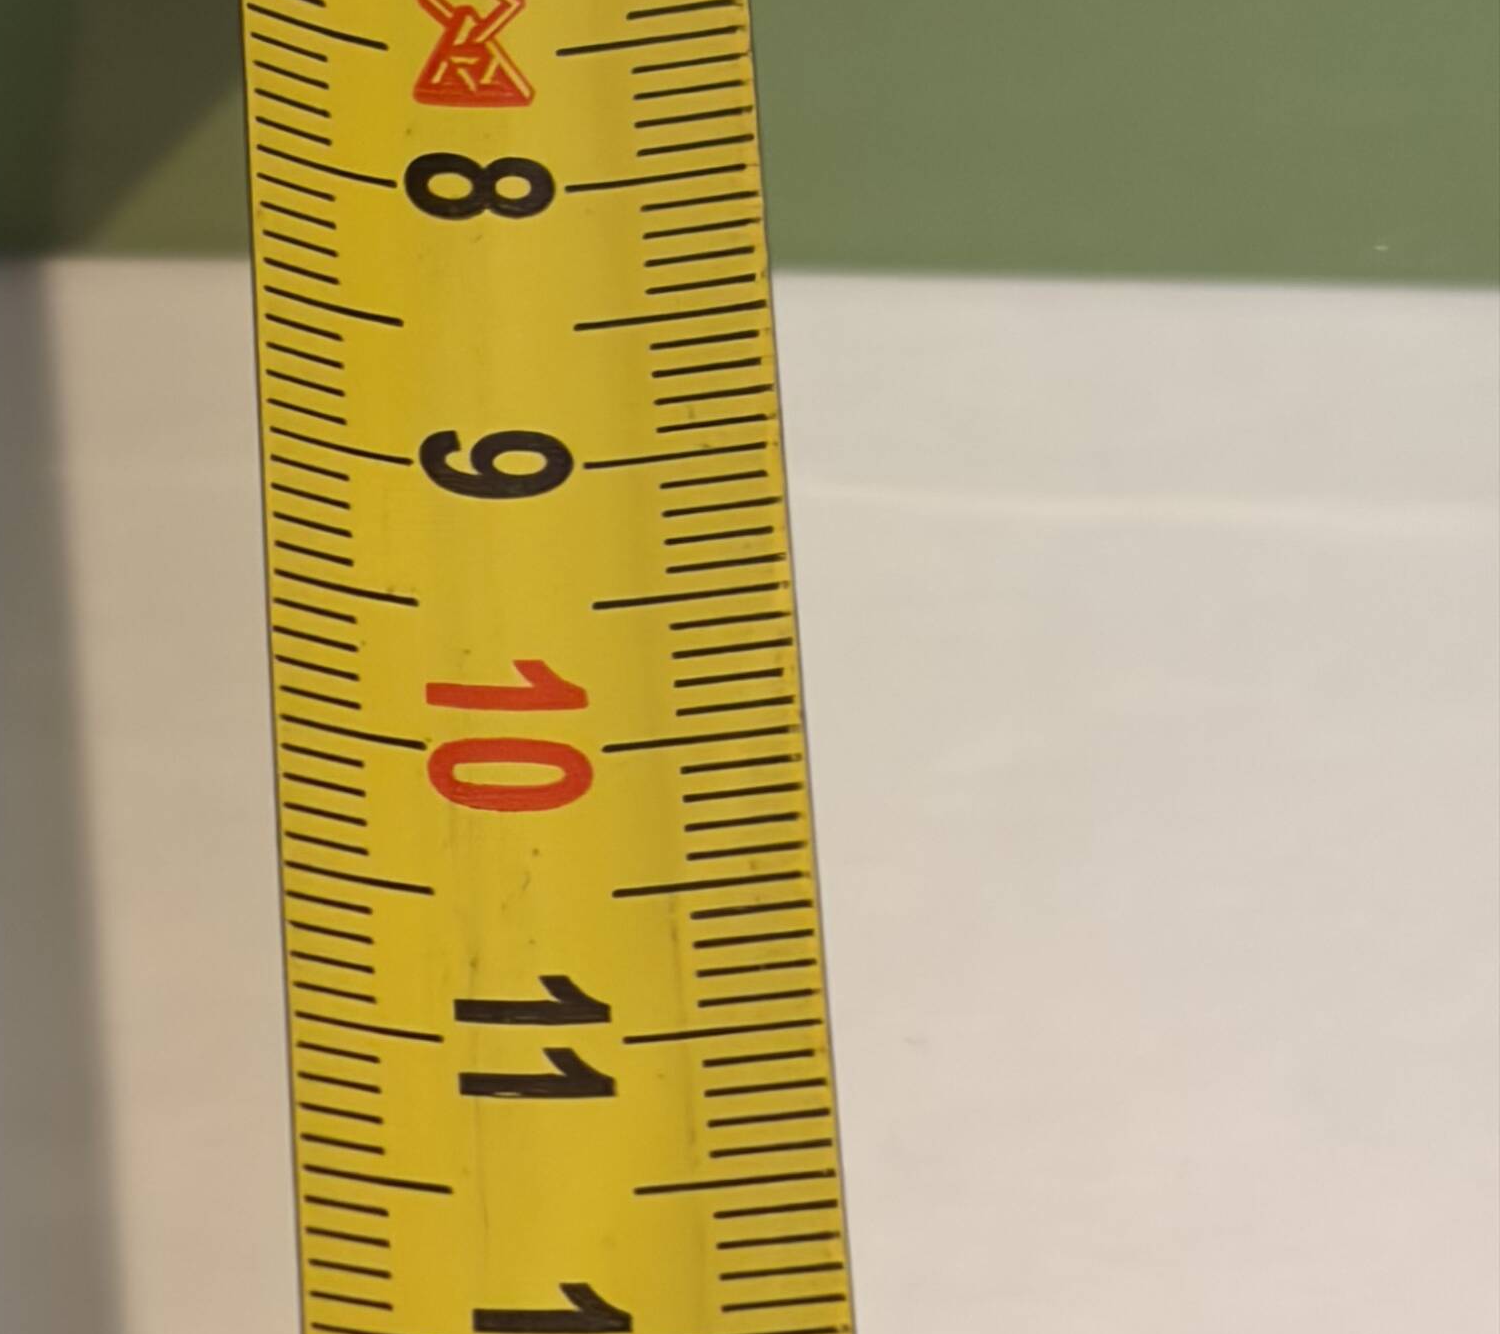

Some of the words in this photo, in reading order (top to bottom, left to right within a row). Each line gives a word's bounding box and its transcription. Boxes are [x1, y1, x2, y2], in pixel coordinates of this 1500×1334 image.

[403, 152, 556, 220] 8
[419, 430, 575, 499] 9
[425, 659, 594, 812] 10
[453, 975, 617, 1099] 11
